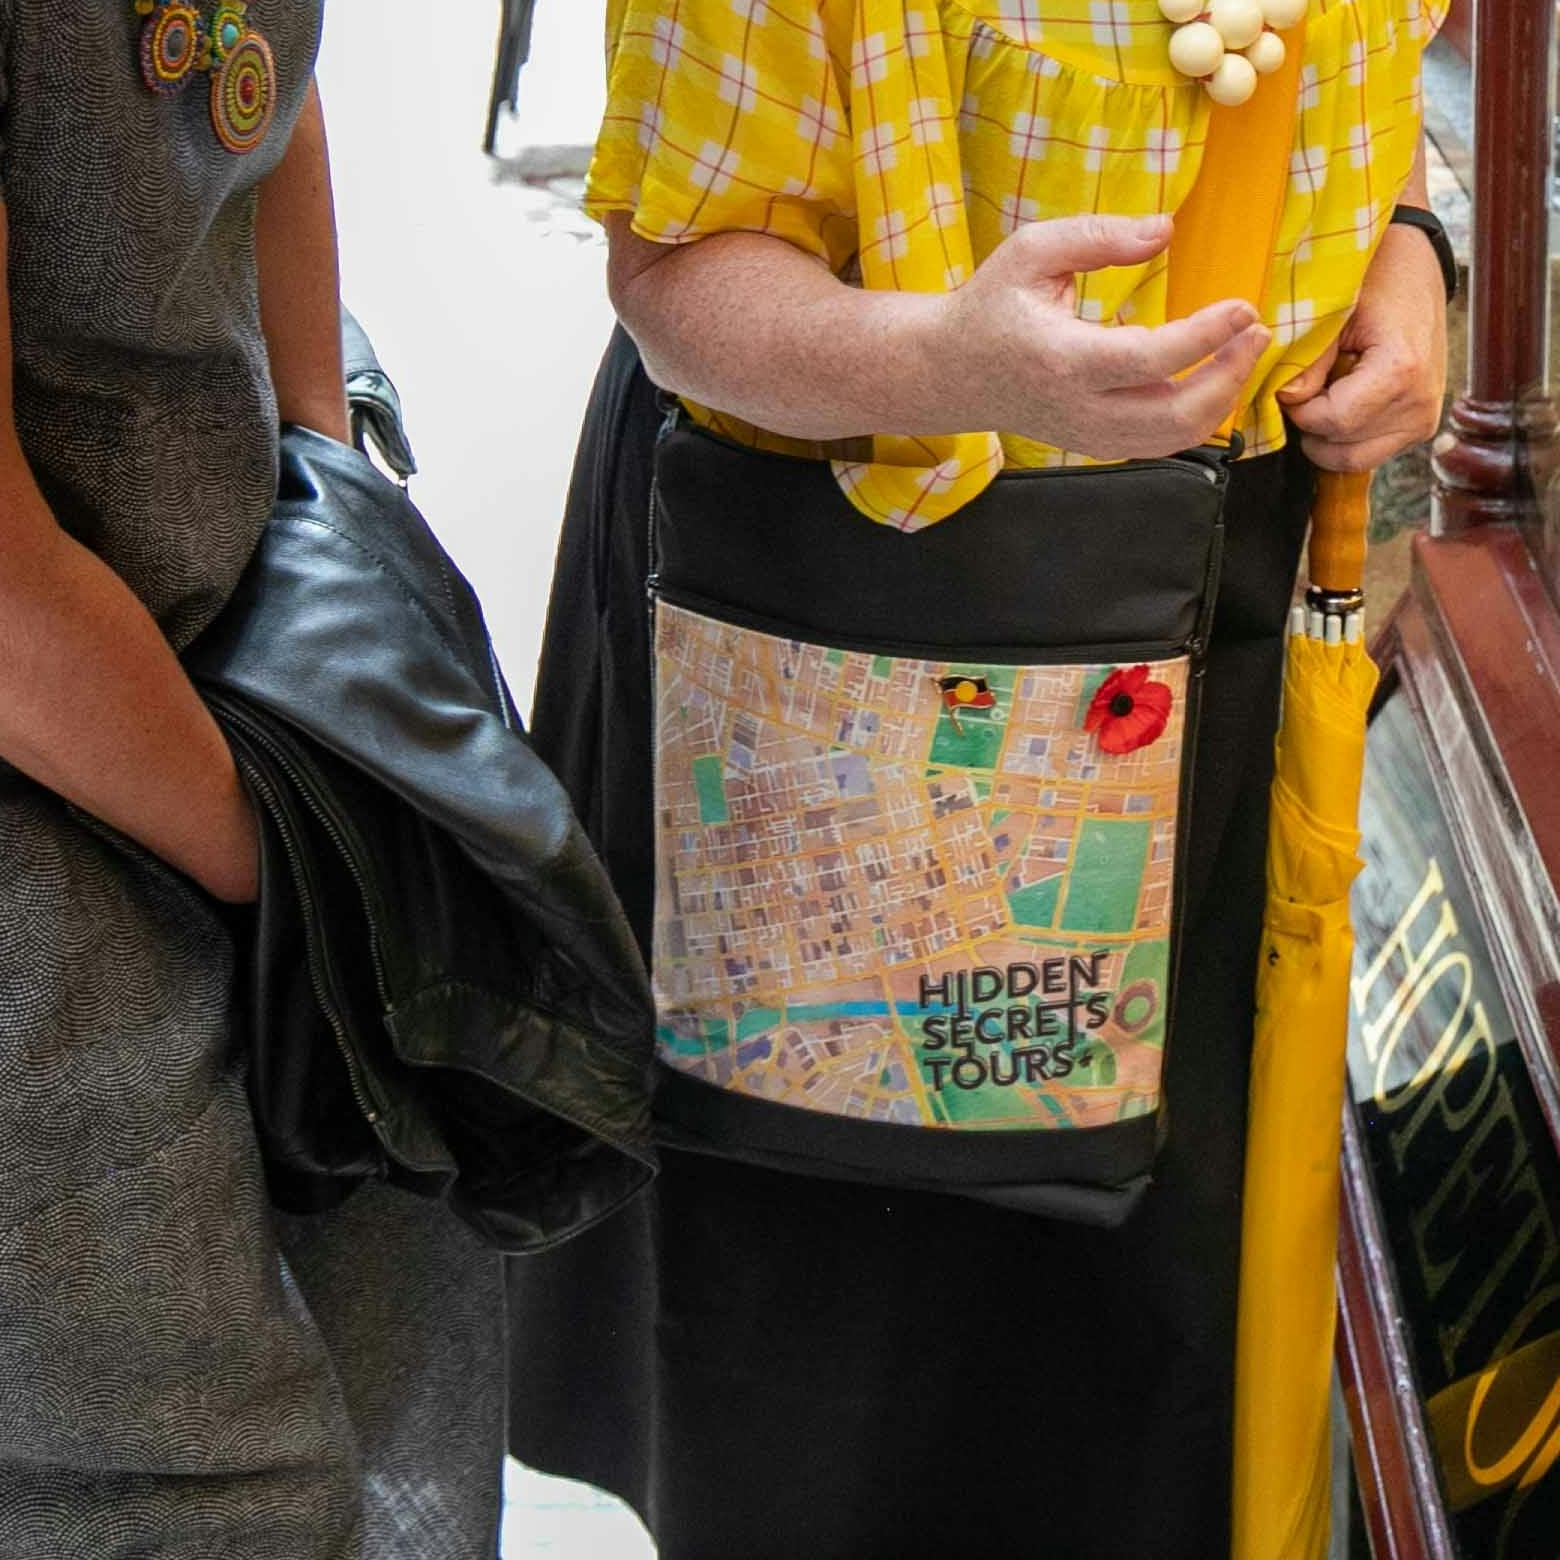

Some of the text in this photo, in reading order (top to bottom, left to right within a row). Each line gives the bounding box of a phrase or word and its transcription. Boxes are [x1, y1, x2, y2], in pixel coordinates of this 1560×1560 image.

[919, 949, 1109, 1012] HIDDEN
[922, 992, 1109, 1050] SECRETS
[924, 1040, 1074, 1091] TOURS
